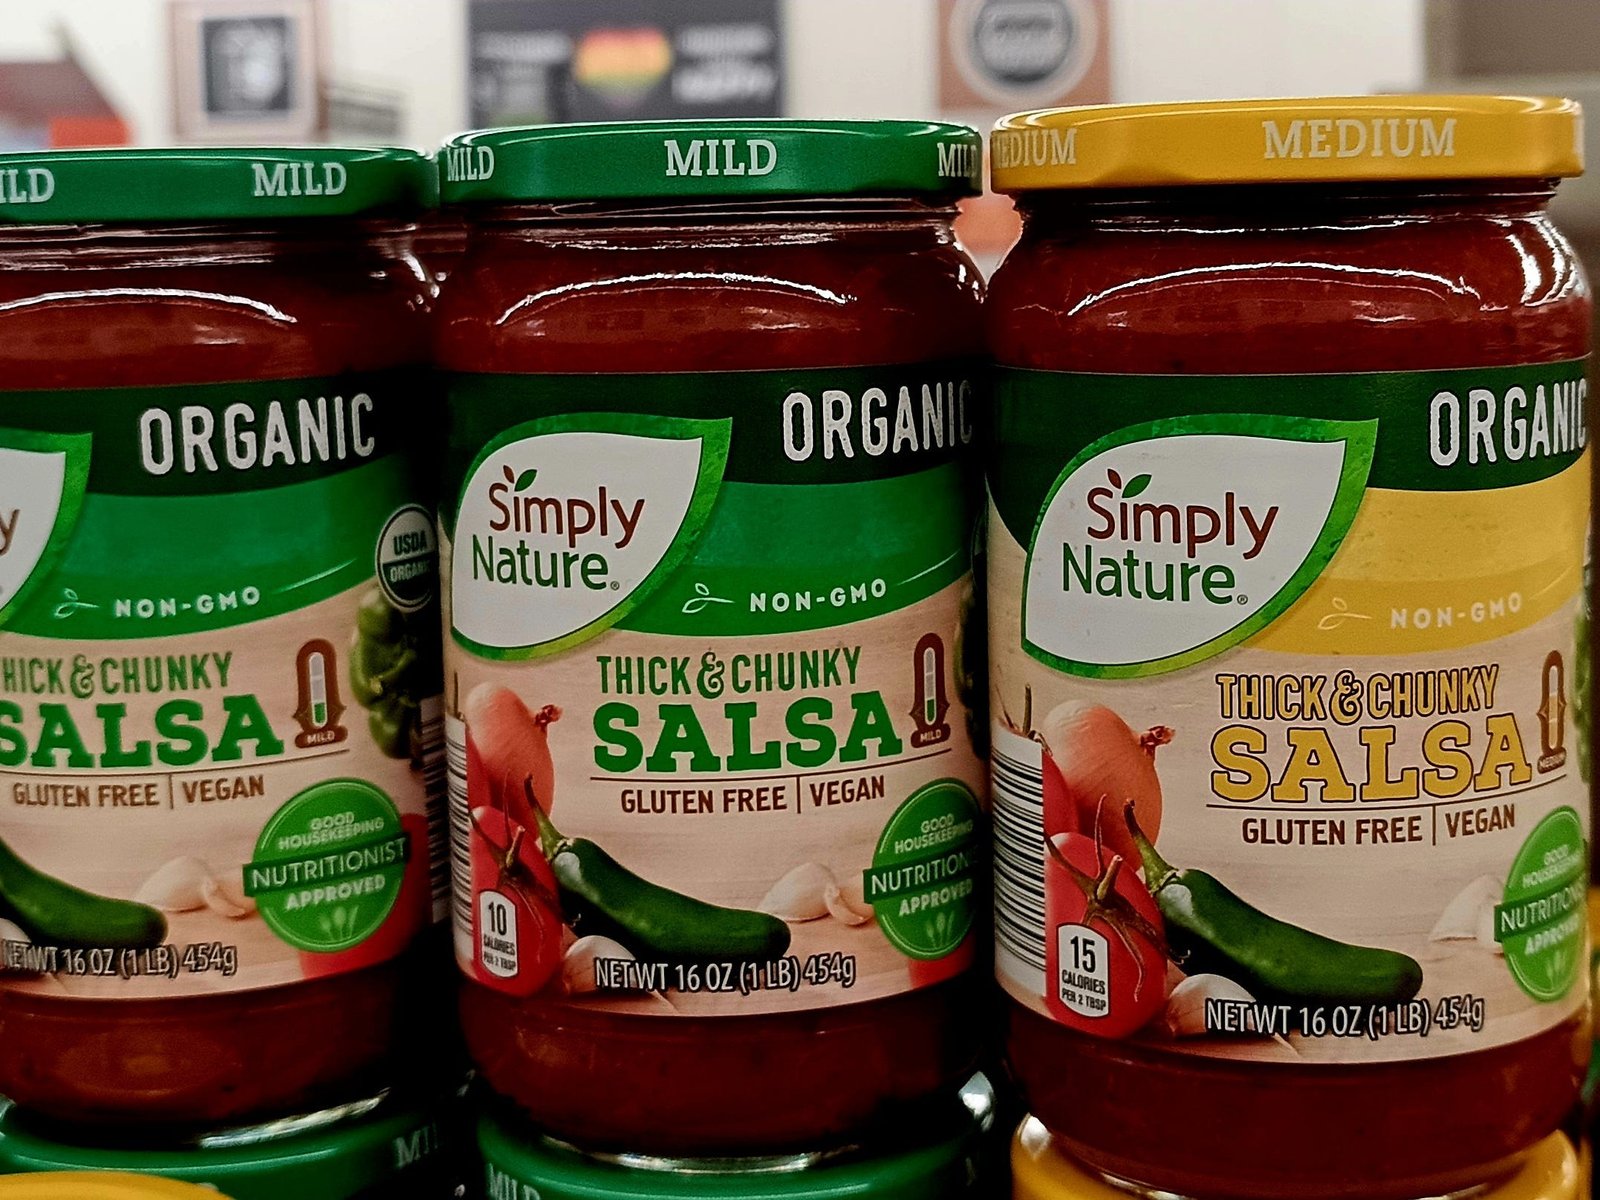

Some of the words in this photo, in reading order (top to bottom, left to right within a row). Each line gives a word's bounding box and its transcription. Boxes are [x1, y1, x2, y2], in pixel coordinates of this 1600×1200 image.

[664, 139, 778, 177] MILD
[1263, 118, 1456, 160] MEDIUM
[251, 162, 347, 197] MILD
[446, 146, 495, 182] MILD
[0, 168, 55, 204] ILD
[139, 393, 375, 475] ORGANIC
[783, 380, 973, 461] ORGANIC
[1430, 378, 1587, 466] ORGANIC
[489, 482, 646, 549] Simply
[1087, 487, 1279, 560] Simply
[393, 530, 428, 556] USDA
[114, 585, 261, 619] NON-GMO
[748, 578, 888, 613] NON-GMO
[1390, 592, 1523, 630] NON-GMO
[1, 657, 65, 694] HICK
[0, 694, 284, 767] SALSA
[307, 730, 335, 744] MILD
[593, 690, 903, 773] SALSA
[920, 729, 942, 742] MILD
[1210, 712, 1532, 803] SALSA
[13, 782, 91, 807] GLUTEN
[98, 783, 160, 807] FREE
[182, 775, 265, 803] VEGAN
[621, 788, 714, 814] GLUTEN
[723, 785, 788, 813] FREE
[809, 775, 885, 807] VEGAN
[278, 817, 385, 850] HOUSEKEEPING
[310, 811, 355, 830] GOOD
[920, 813, 955, 834] GOOD
[1242, 817, 1346, 845] GLUTEN
[1355, 815, 1423, 844] FREE
[1445, 804, 1515, 838] VEGAN
[251, 837, 407, 889] NUTRITIONIST
[284, 874, 387, 912] APPROVED
[488, 901, 507, 936] 10
[63, 948, 86, 975] 16
[91, 948, 115, 975] OZ
[120, 948, 138, 978] (1
[146, 946, 179, 978] LB)
[183, 943, 237, 976] 454g
[1070, 935, 1096, 973] 15
[595, 959, 631, 988] NET
[635, 963, 668, 990] WT
[675, 964, 701, 991] 16
[706, 962, 733, 991] OZ
[739, 961, 758, 995] (1
[766, 958, 799, 990] LB)
[805, 952, 856, 986] 454g
[1061, 969, 1106, 995] CALORIES
[1062, 988, 1076, 1003] PER
[1078, 994, 1083, 1005] 2
[1086, 996, 1107, 1011] TBSP
[1207, 1000, 1248, 1032] NET
[1254, 1005, 1291, 1034] WT
[1300, 1006, 1326, 1035] 16
[1332, 1006, 1362, 1035] OZ
[1368, 1004, 1388, 1039] (1
[1397, 1000, 1430, 1036] LB)
[1435, 996, 1485, 1031] 454g
